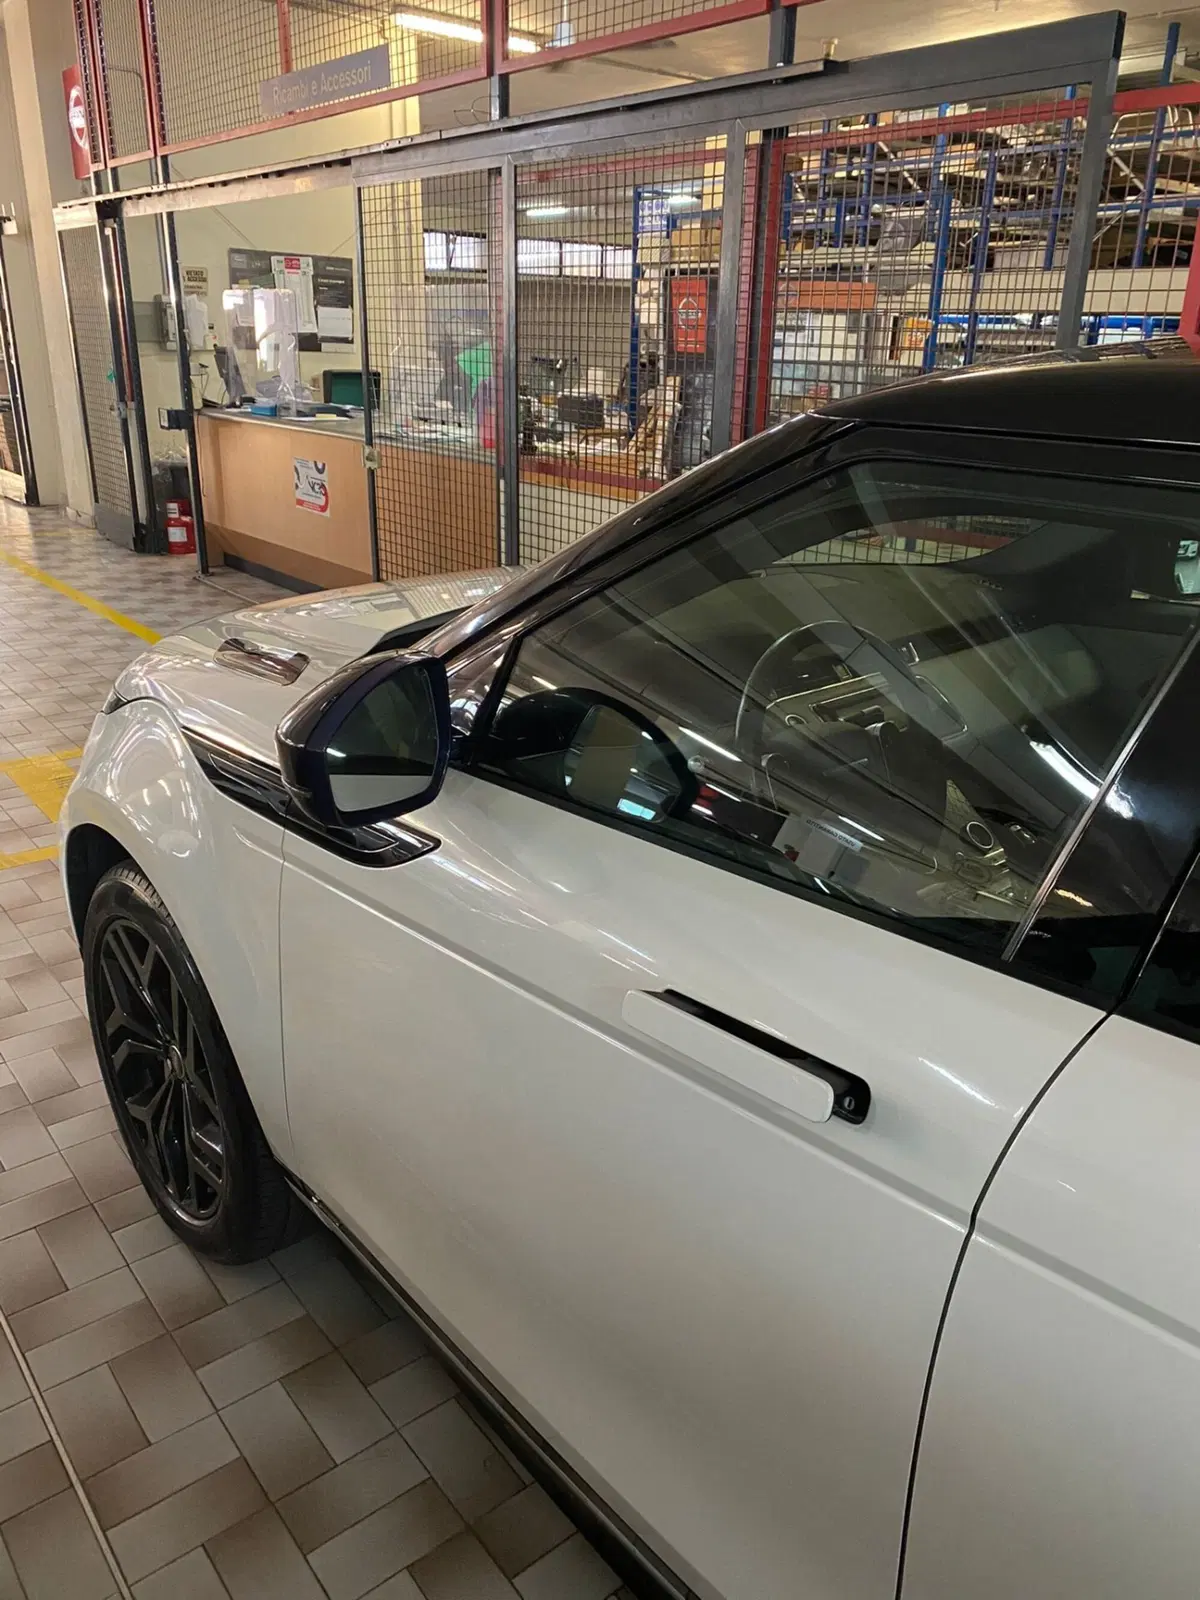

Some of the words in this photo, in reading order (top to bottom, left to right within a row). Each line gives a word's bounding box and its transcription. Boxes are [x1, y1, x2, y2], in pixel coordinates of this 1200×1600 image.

[273, 77, 309, 105] Ricambi
[311, 79, 318, 96] e
[320, 60, 371, 94] Accessori
